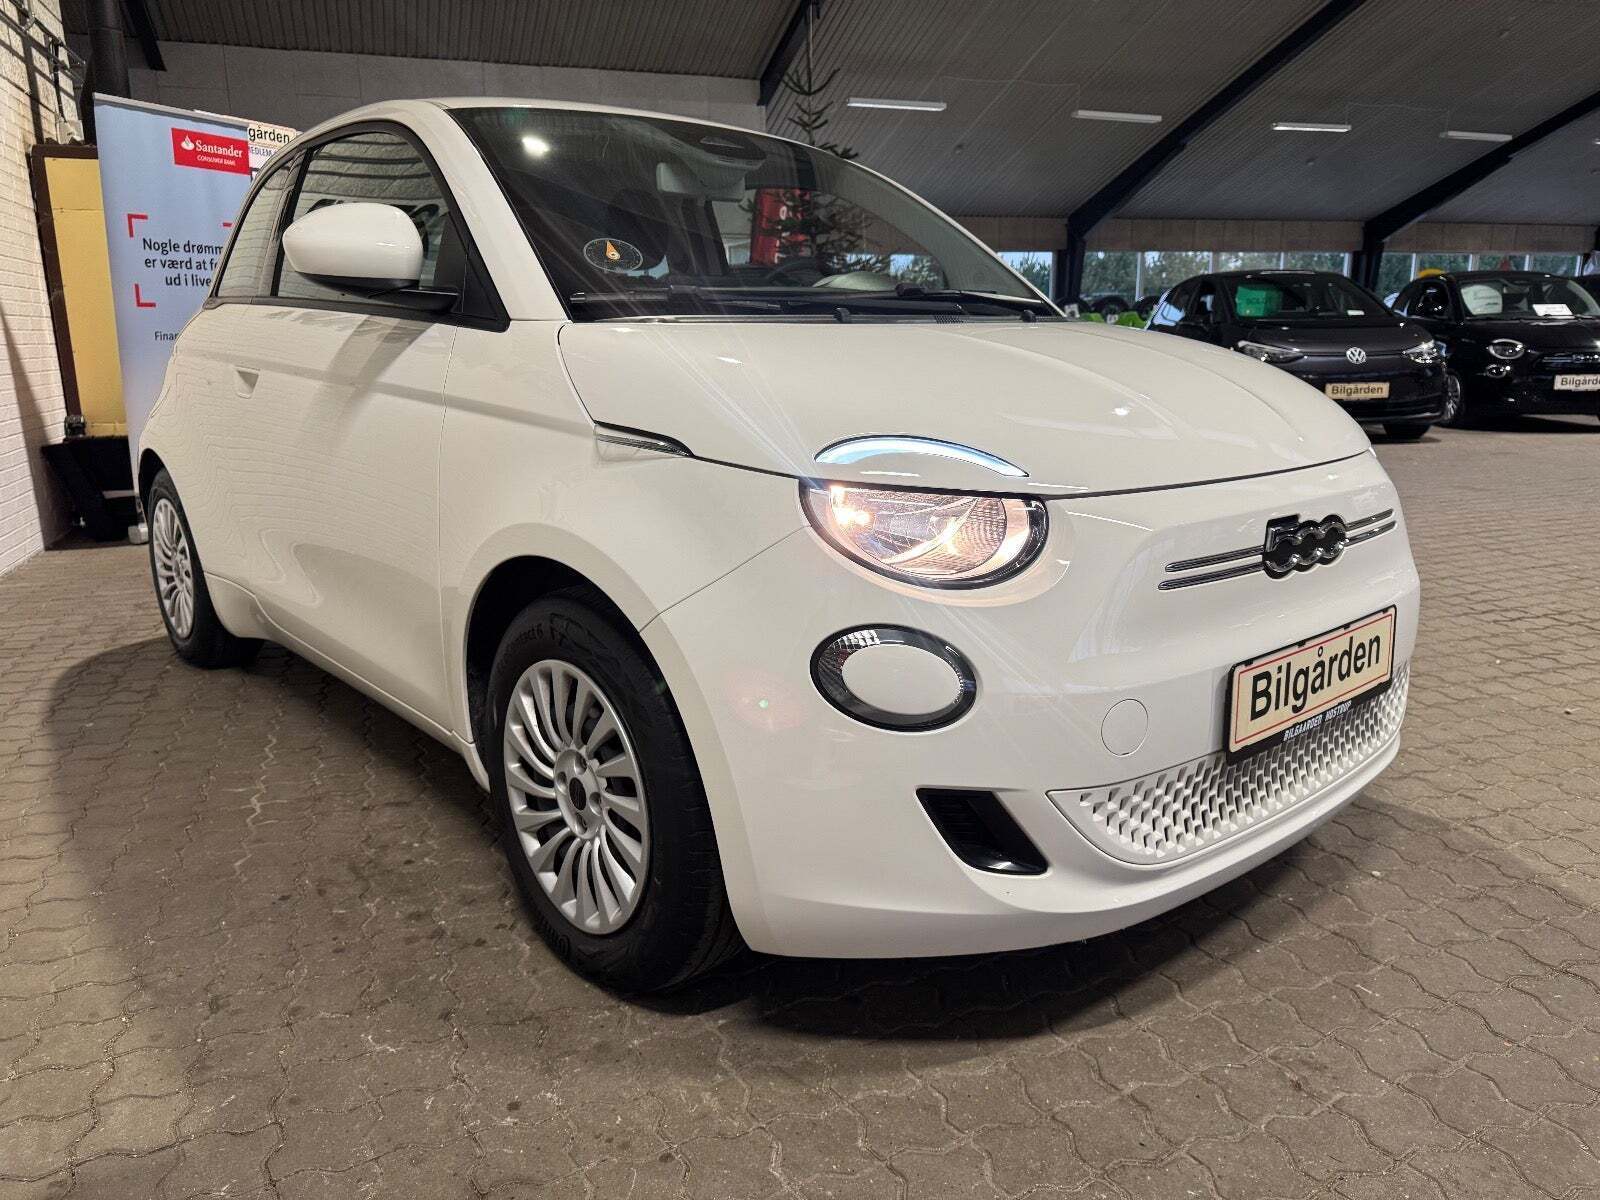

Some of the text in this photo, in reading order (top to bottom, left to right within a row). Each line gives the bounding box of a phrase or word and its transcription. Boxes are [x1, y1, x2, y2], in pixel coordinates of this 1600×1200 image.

[248, 125, 291, 144] gården
[195, 139, 243, 158] Santander
[142, 238, 180, 255] Nogle
[144, 257, 157, 268] er
[160, 257, 193, 270] værd
[196, 259, 208, 270] at
[165, 273, 212, 287] ud i live
[1331, 384, 1384, 397] Bilgården
[1561, 376, 1600, 388] Bilgård
[1264, 514, 1346, 579] 500
[1250, 635, 1381, 722] Bilgården
